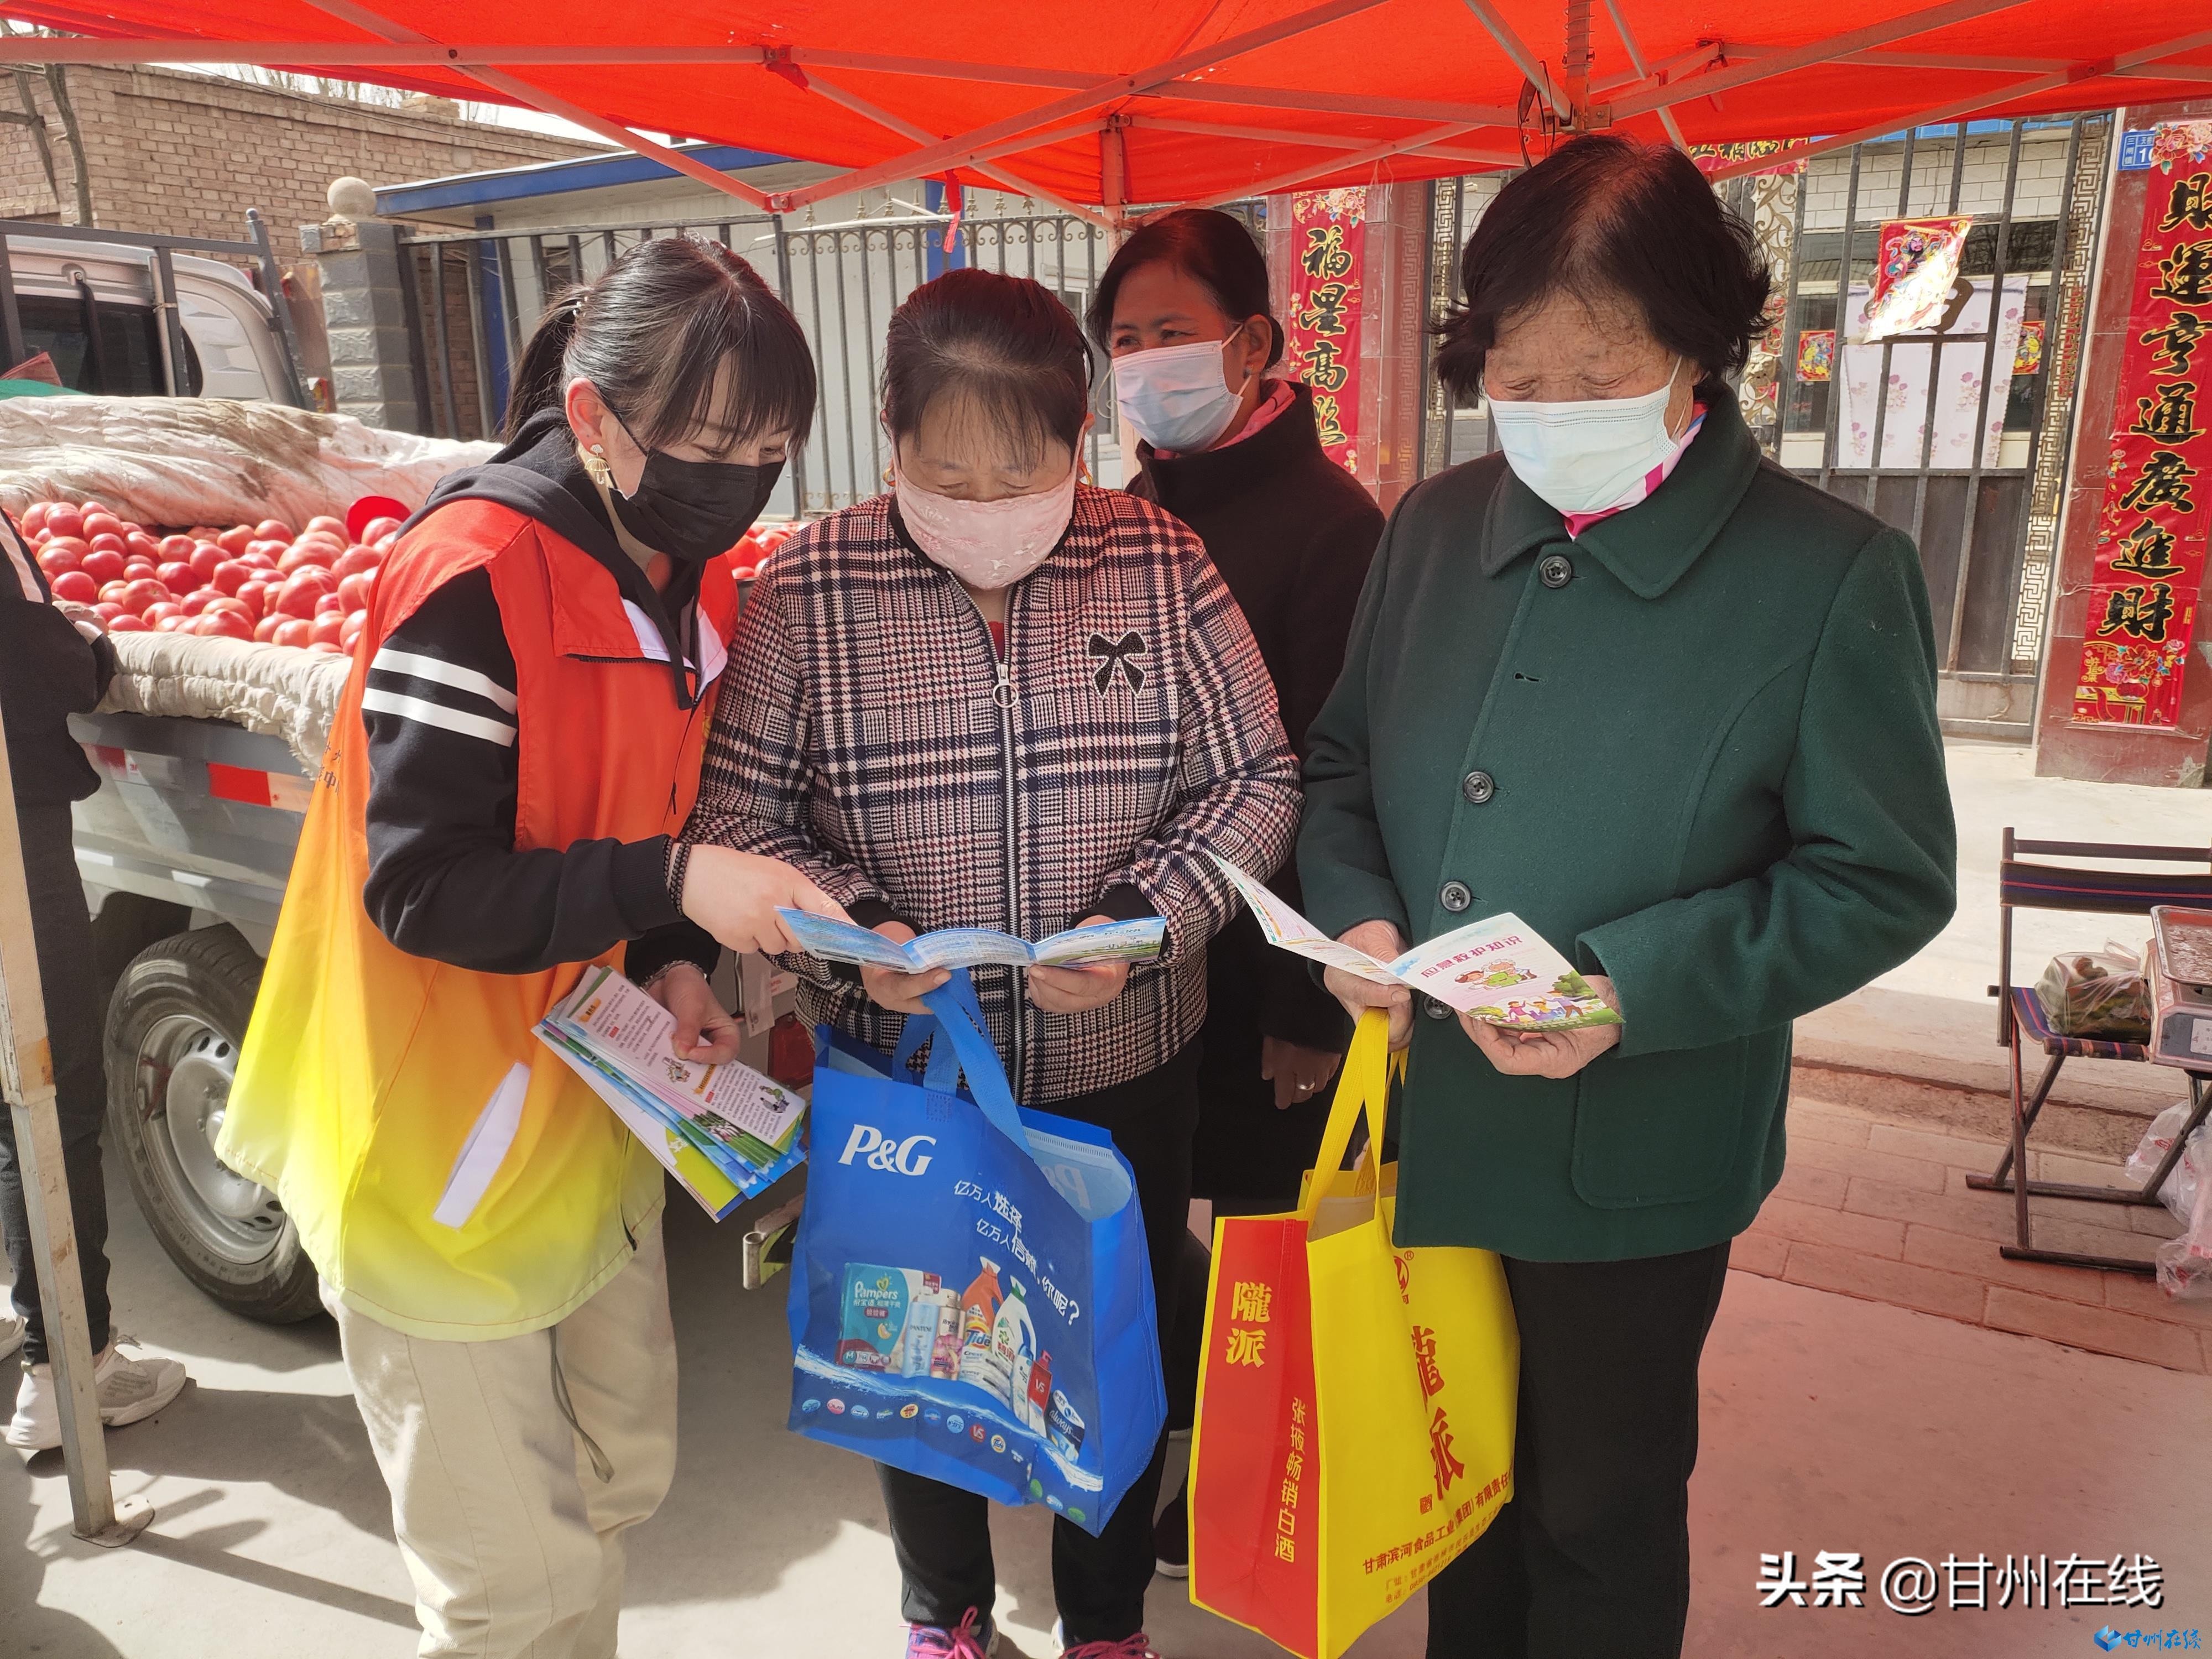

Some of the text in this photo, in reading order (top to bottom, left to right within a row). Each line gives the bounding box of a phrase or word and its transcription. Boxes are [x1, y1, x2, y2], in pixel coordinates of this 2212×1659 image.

[1421, 936, 1522, 978] 应急救护知识
[838, 1124, 937, 1176] P&G
[855, 1281, 898, 1301] Pampers
[965, 1330, 992, 1347] Tide
[1274, 1397, 1306, 1563] 张掖畅销白酒
